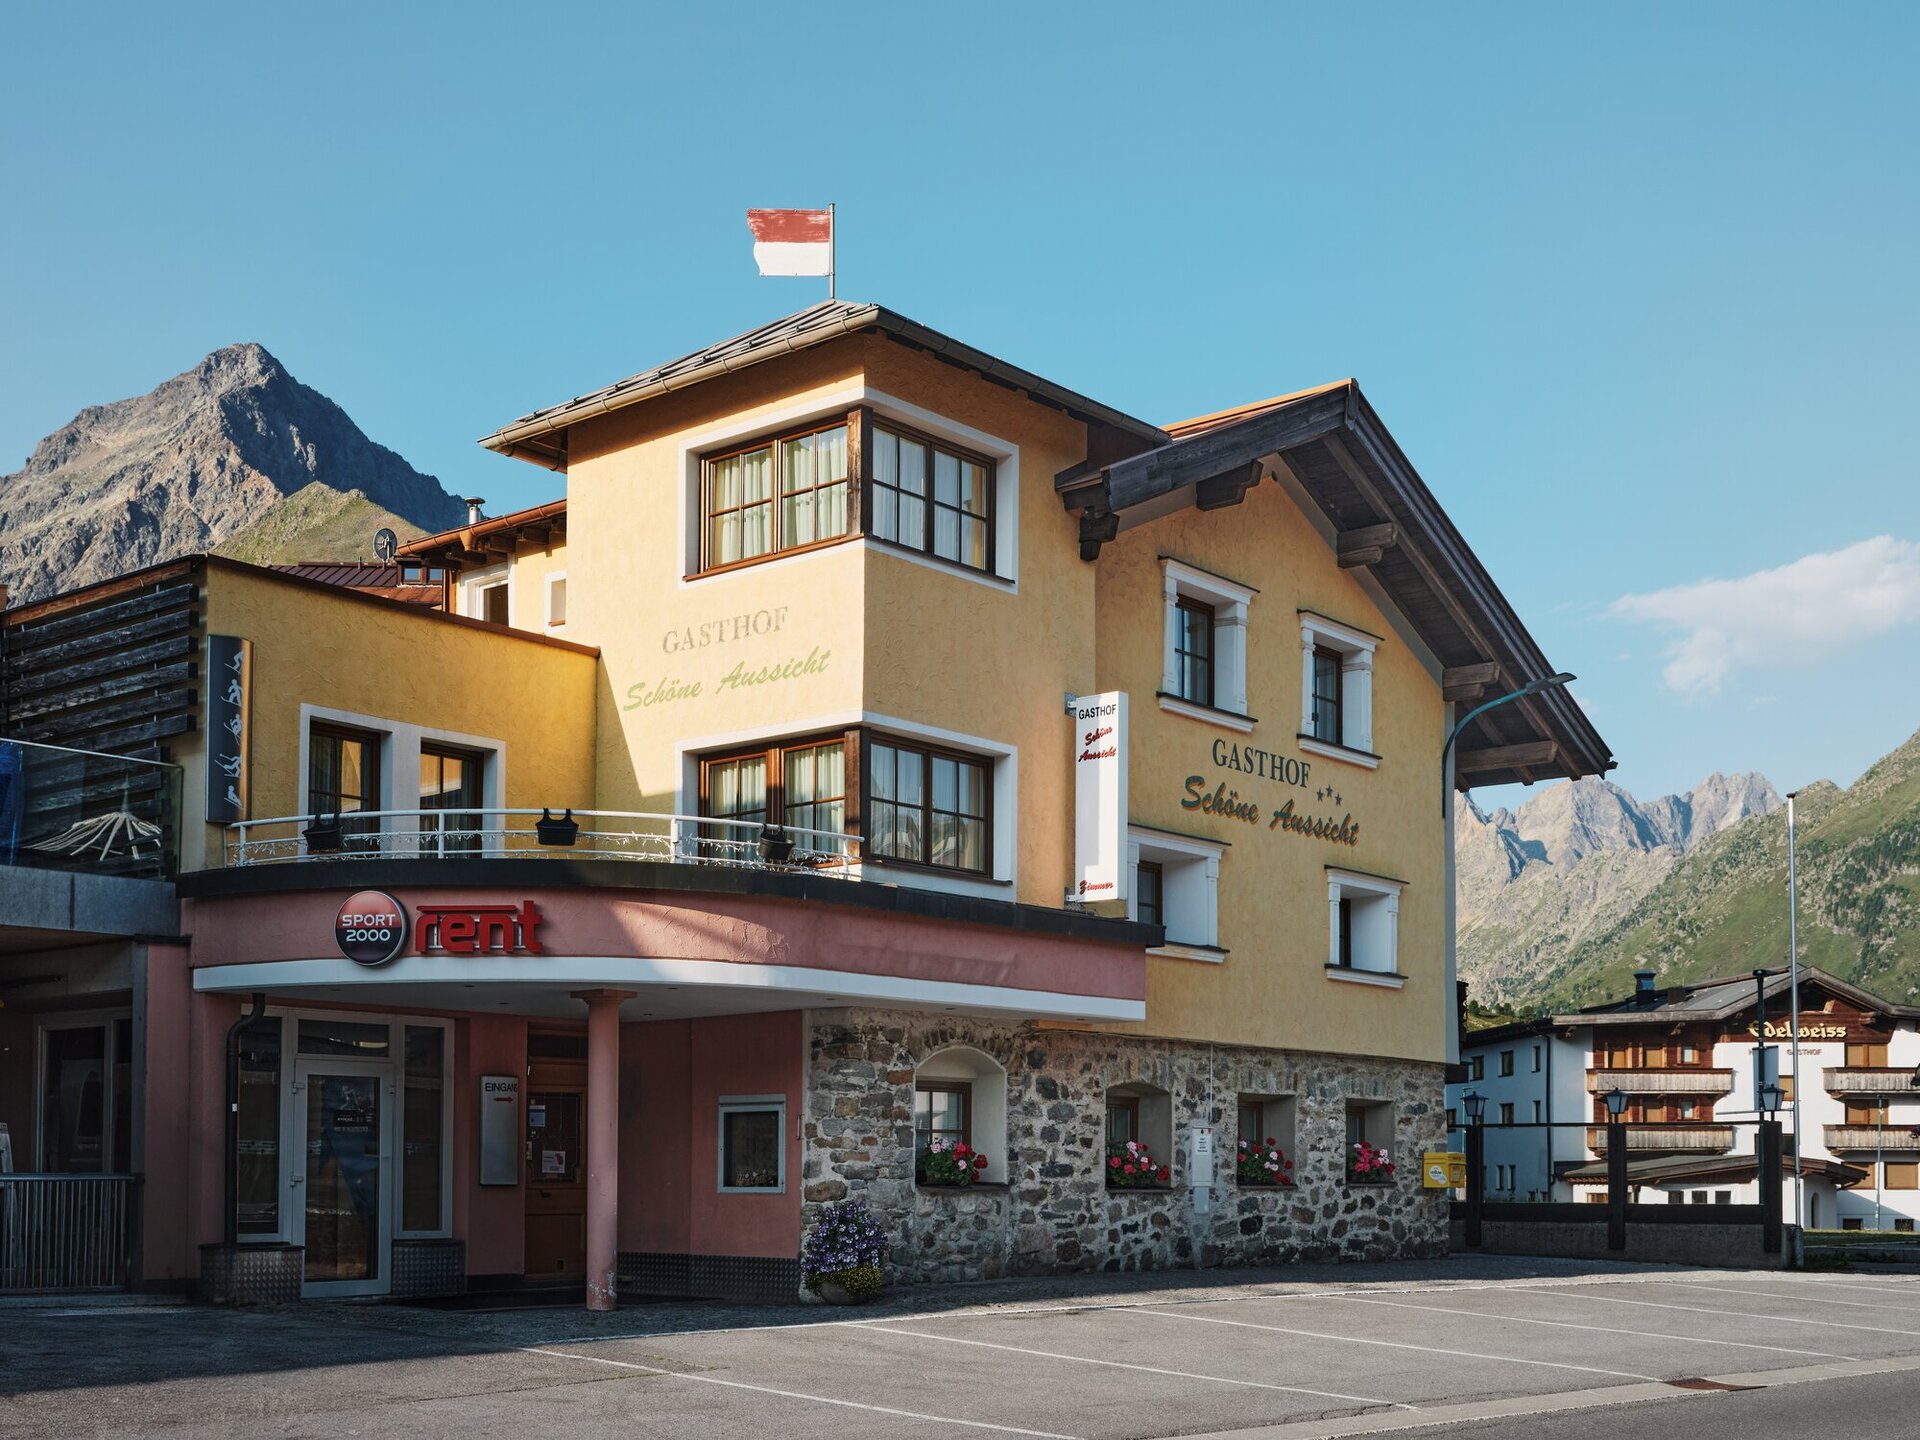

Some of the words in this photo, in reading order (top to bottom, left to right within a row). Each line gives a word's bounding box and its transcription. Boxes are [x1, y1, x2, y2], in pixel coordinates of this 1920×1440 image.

[662, 606, 788, 654] GASTHOF
[623, 677, 702, 712] Schöne
[716, 646, 832, 695] Aussicht
[1078, 704, 1117, 720] GASTHOF
[1212, 738, 1311, 788] GASTHOF
[1181, 775, 1260, 824] Schöne
[1269, 799, 1360, 847] Aussicht
[342, 913, 396, 927] SPORT
[346, 929, 391, 942] 2000
[415, 900, 544, 954] rent
[1786, 1048, 1823, 1056] GSTHOF
